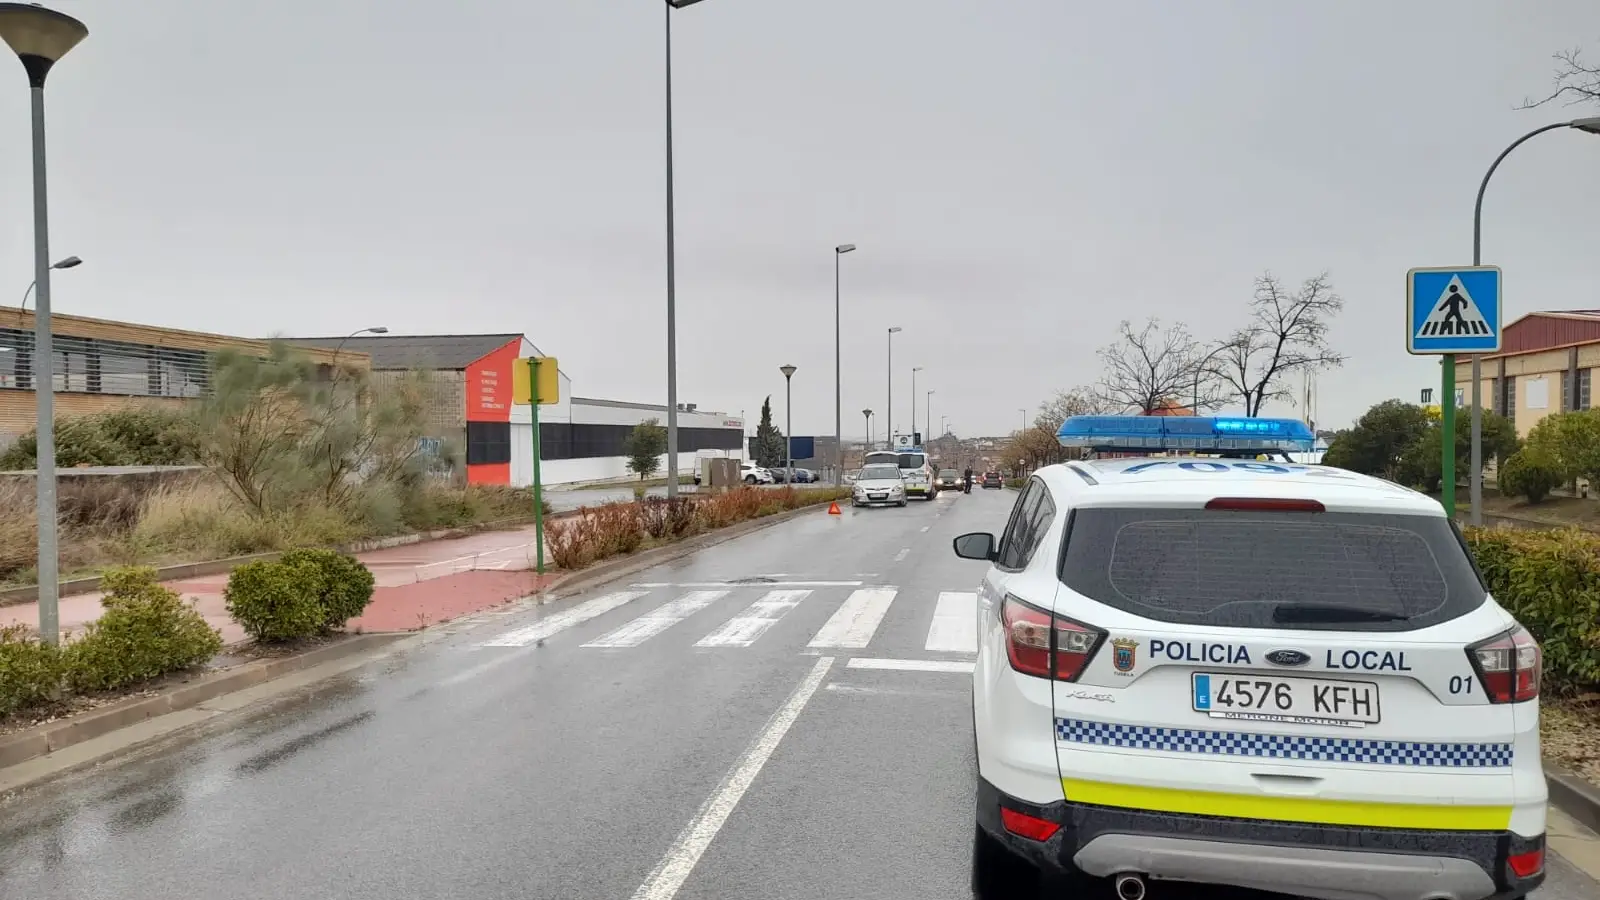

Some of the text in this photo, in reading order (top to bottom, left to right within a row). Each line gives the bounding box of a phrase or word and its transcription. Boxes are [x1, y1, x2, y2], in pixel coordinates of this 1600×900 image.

[1149, 639, 1412, 672] POLICIA LOCAL
[1273, 651, 1304, 664] Ford
[1449, 675, 1473, 694] 01
[1199, 695, 1207, 704] E
[1216, 679, 1371, 716] 4576 KFH
